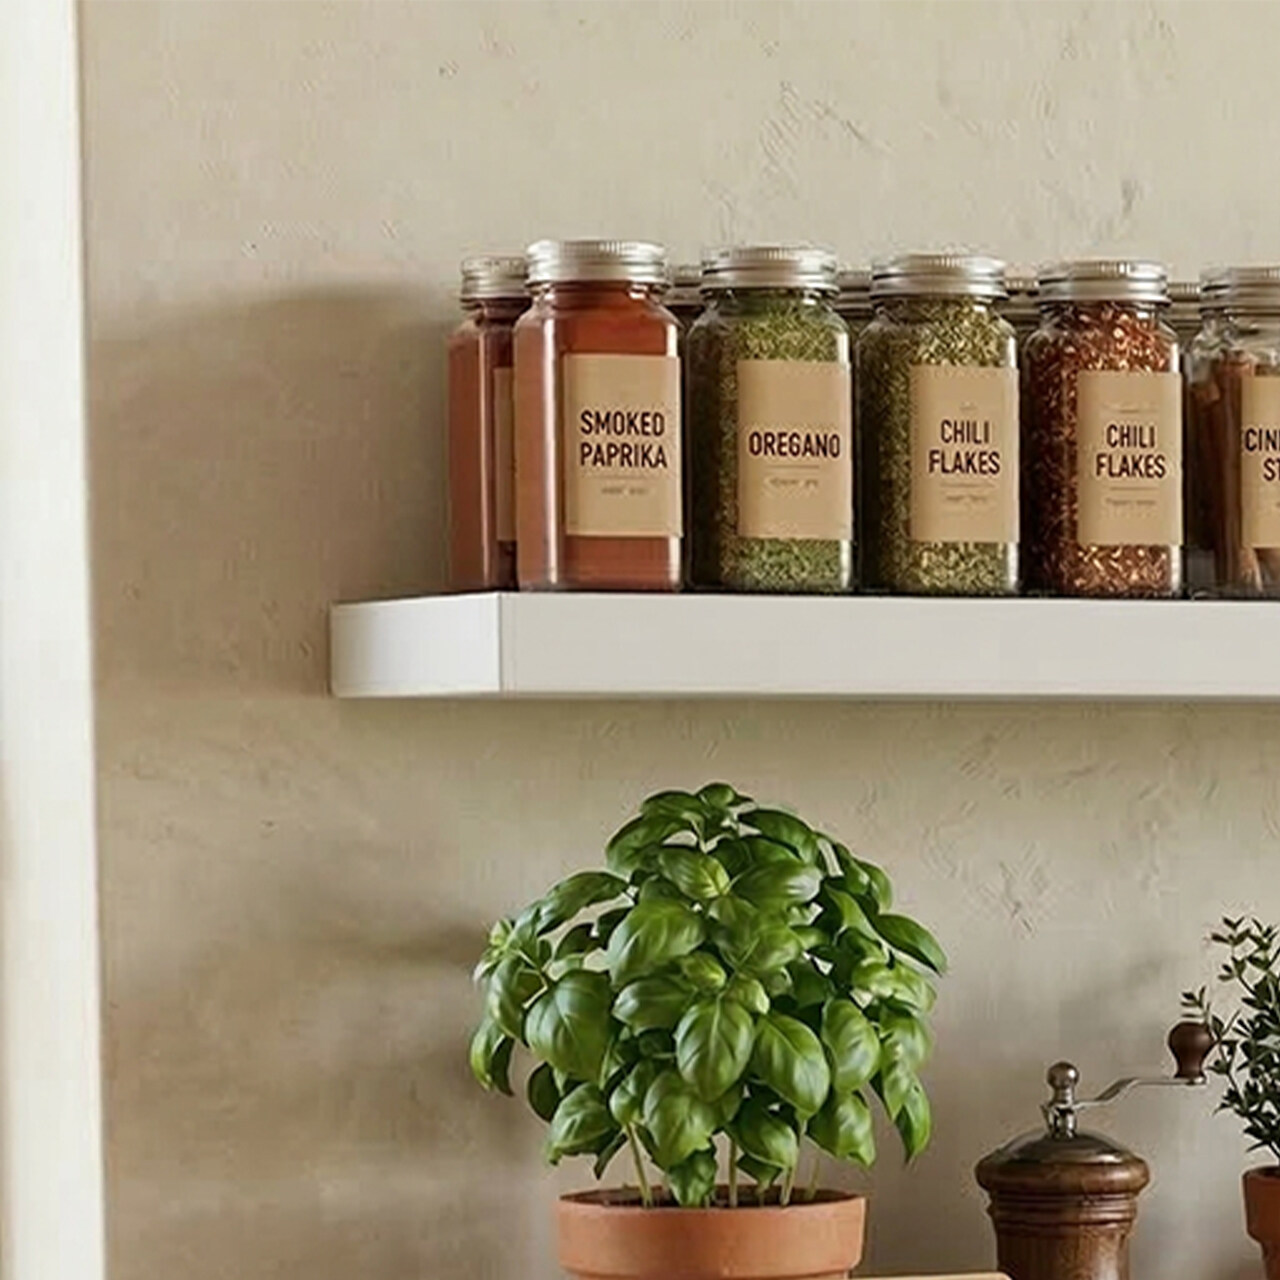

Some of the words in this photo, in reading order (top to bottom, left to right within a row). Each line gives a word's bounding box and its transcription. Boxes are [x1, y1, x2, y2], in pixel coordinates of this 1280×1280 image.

[580, 410, 665, 436] SMOKED
[940, 419, 990, 444] CHILI
[749, 431, 841, 458] OREGANO
[1106, 424, 1156, 449] CHILI
[580, 442, 667, 468] PAPRIKA
[928, 449, 1001, 475] FLAKES
[1096, 453, 1167, 479] FLAKES
